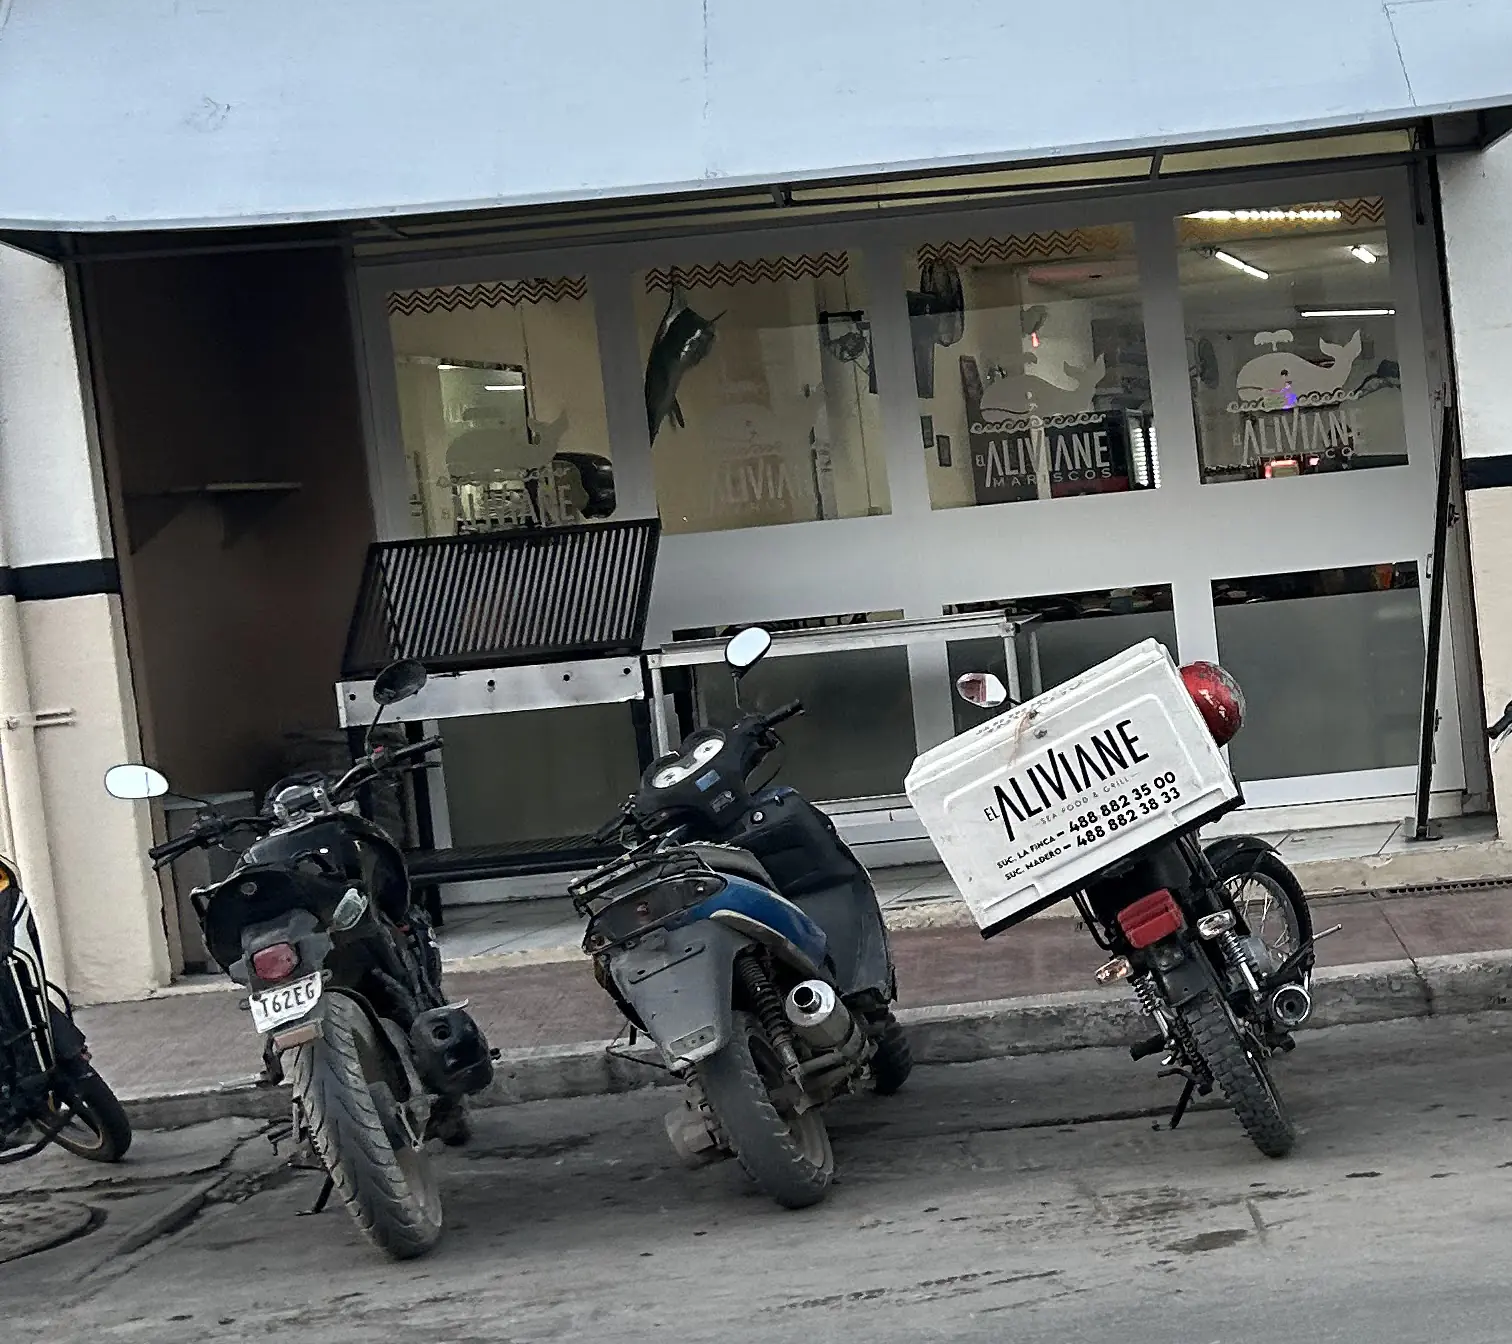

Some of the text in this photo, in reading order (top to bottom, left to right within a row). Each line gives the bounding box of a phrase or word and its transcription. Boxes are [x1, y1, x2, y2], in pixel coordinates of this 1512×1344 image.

[985, 427, 1110, 488] ALIVIANE
[983, 718, 1150, 842] EL ALIVIANE
[1040, 812, 1057, 825] SEA
[1061, 796, 1089, 814] FOOD
[1103, 776, 1130, 793] GRILL
[996, 854, 1017, 869] SUC.
[1016, 845, 1030, 859] LA
[1030, 835, 1056, 853] FINCA
[1069, 811, 1098, 833] 488
[1100, 794, 1131, 817] 882
[1131, 783, 1152, 801] 35
[1153, 771, 1177, 789] 00
[1004, 866, 1025, 881] SUC.
[1025, 847, 1062, 871] MADERO
[1076, 825, 1106, 848] 488
[1107, 808, 1138, 831] 882
[1138, 797, 1160, 815] 38
[1160, 786, 1181, 804] 33
[260, 982, 315, 1017] T62EG
